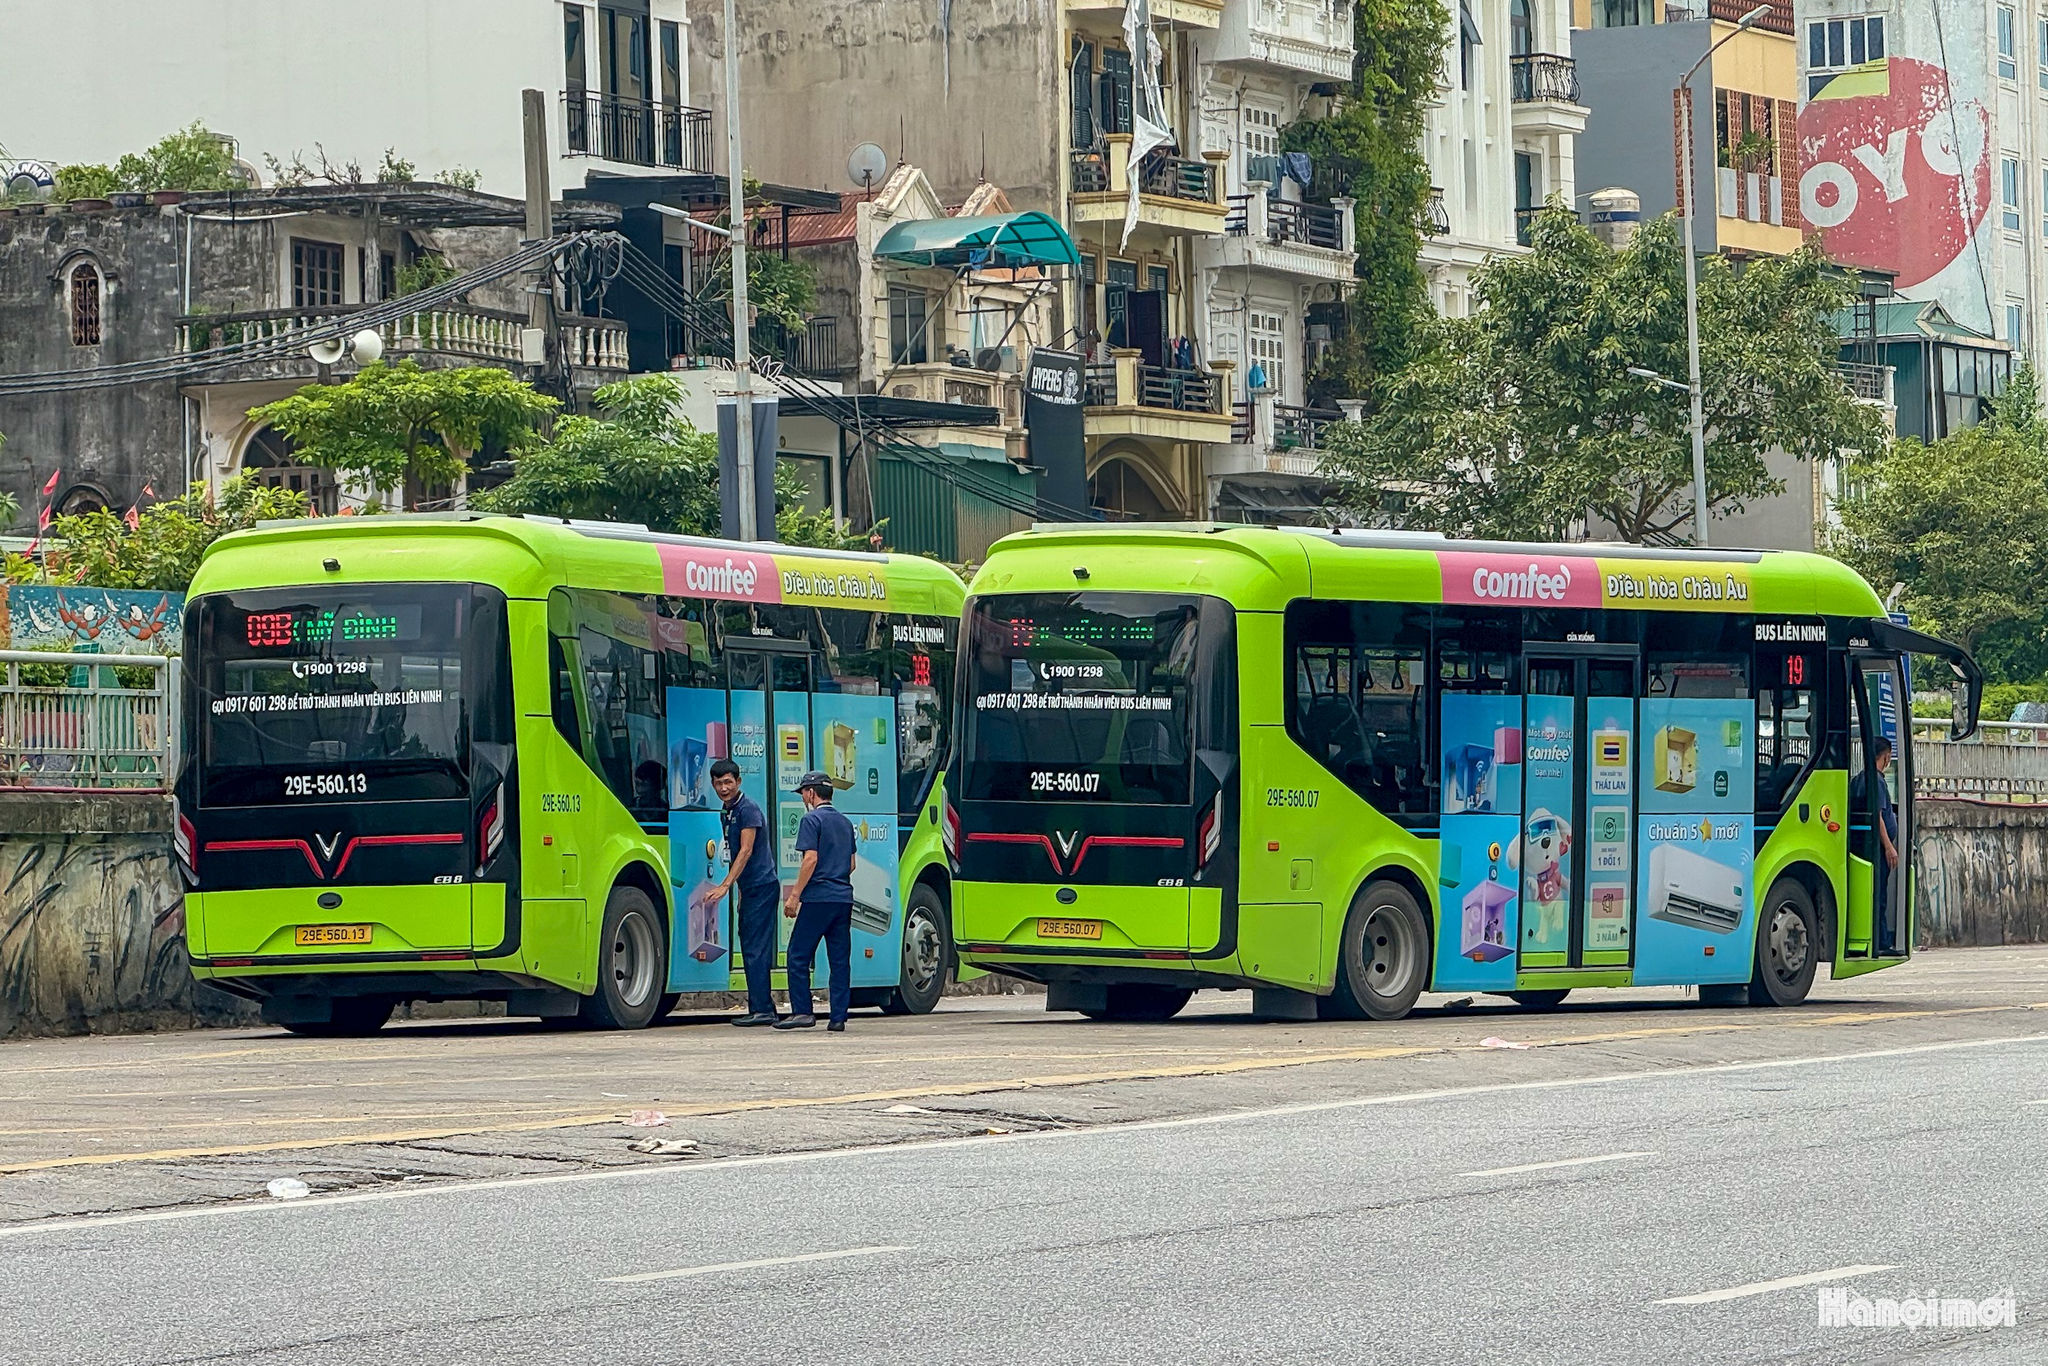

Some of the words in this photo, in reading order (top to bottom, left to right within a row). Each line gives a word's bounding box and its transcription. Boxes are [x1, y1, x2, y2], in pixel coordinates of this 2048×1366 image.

[1799, 103, 1985, 228] OYO
[1031, 366, 1063, 393] HYPER5
[783, 570, 811, 595] Điều
[812, 572, 836, 596] hòa
[838, 574, 867, 599] Châu
[868, 572, 886, 600] Âu
[1607, 573, 1645, 598] Điều
[1647, 574, 1679, 599] hòa
[1682, 576, 1722, 600] Châu
[1726, 573, 1747, 600] Âu
[343, 610, 397, 640] ĐÌNH
[893, 625, 908, 642] BUS
[908, 622, 925, 643] LIÊN
[926, 627, 945, 643] NINH
[1755, 624, 1776, 641] BUS
[1777, 620, 1800, 641] LIÊN
[1801, 625, 1826, 642] NINH
[303, 662, 333, 675] 1900
[336, 661, 367, 674] 1298
[1049, 666, 1075, 677] 1900
[1077, 666, 1103, 677] 1298
[1787, 655, 1804, 685] 19
[212, 700, 224, 716] GỌI
[225, 696, 248, 713] 0917
[249, 695, 266, 712] 601
[268, 694, 287, 711] 298
[299, 693, 313, 709] TRỞ
[314, 693, 340, 709] THÀNH
[341, 692, 364, 708] NHÂN
[364, 691, 383, 707] VIÊN
[385, 691, 401, 706] BUS
[401, 689, 420, 704] LIÊN
[420, 689, 442, 703] NINH
[987, 693, 1006, 709] 0917
[1006, 693, 1020, 709] 601
[1022, 693, 1038, 709] 298
[1084, 694, 1103, 709] NHÂN
[1104, 694, 1120, 709] VIÊN
[1120, 697, 1135, 709] BUS
[1135, 695, 1151, 709] LIÊN
[1152, 697, 1172, 710] NINH
[284, 773, 367, 796] 29E-560.13
[1030, 772, 1100, 793] 29E-560.07
[1595, 778, 1611, 790] THÁI
[1612, 780, 1626, 790] LAN
[541, 793, 581, 813] 29E-560.13
[1267, 788, 1319, 808] 29E-560.07
[1648, 821, 1688, 841] Chuẩn
[1690, 823, 1698, 840] 5
[1715, 822, 1739, 840] mới
[302, 928, 365, 942] 29E-560.13
[1043, 922, 1096, 936] 29E-560.07
